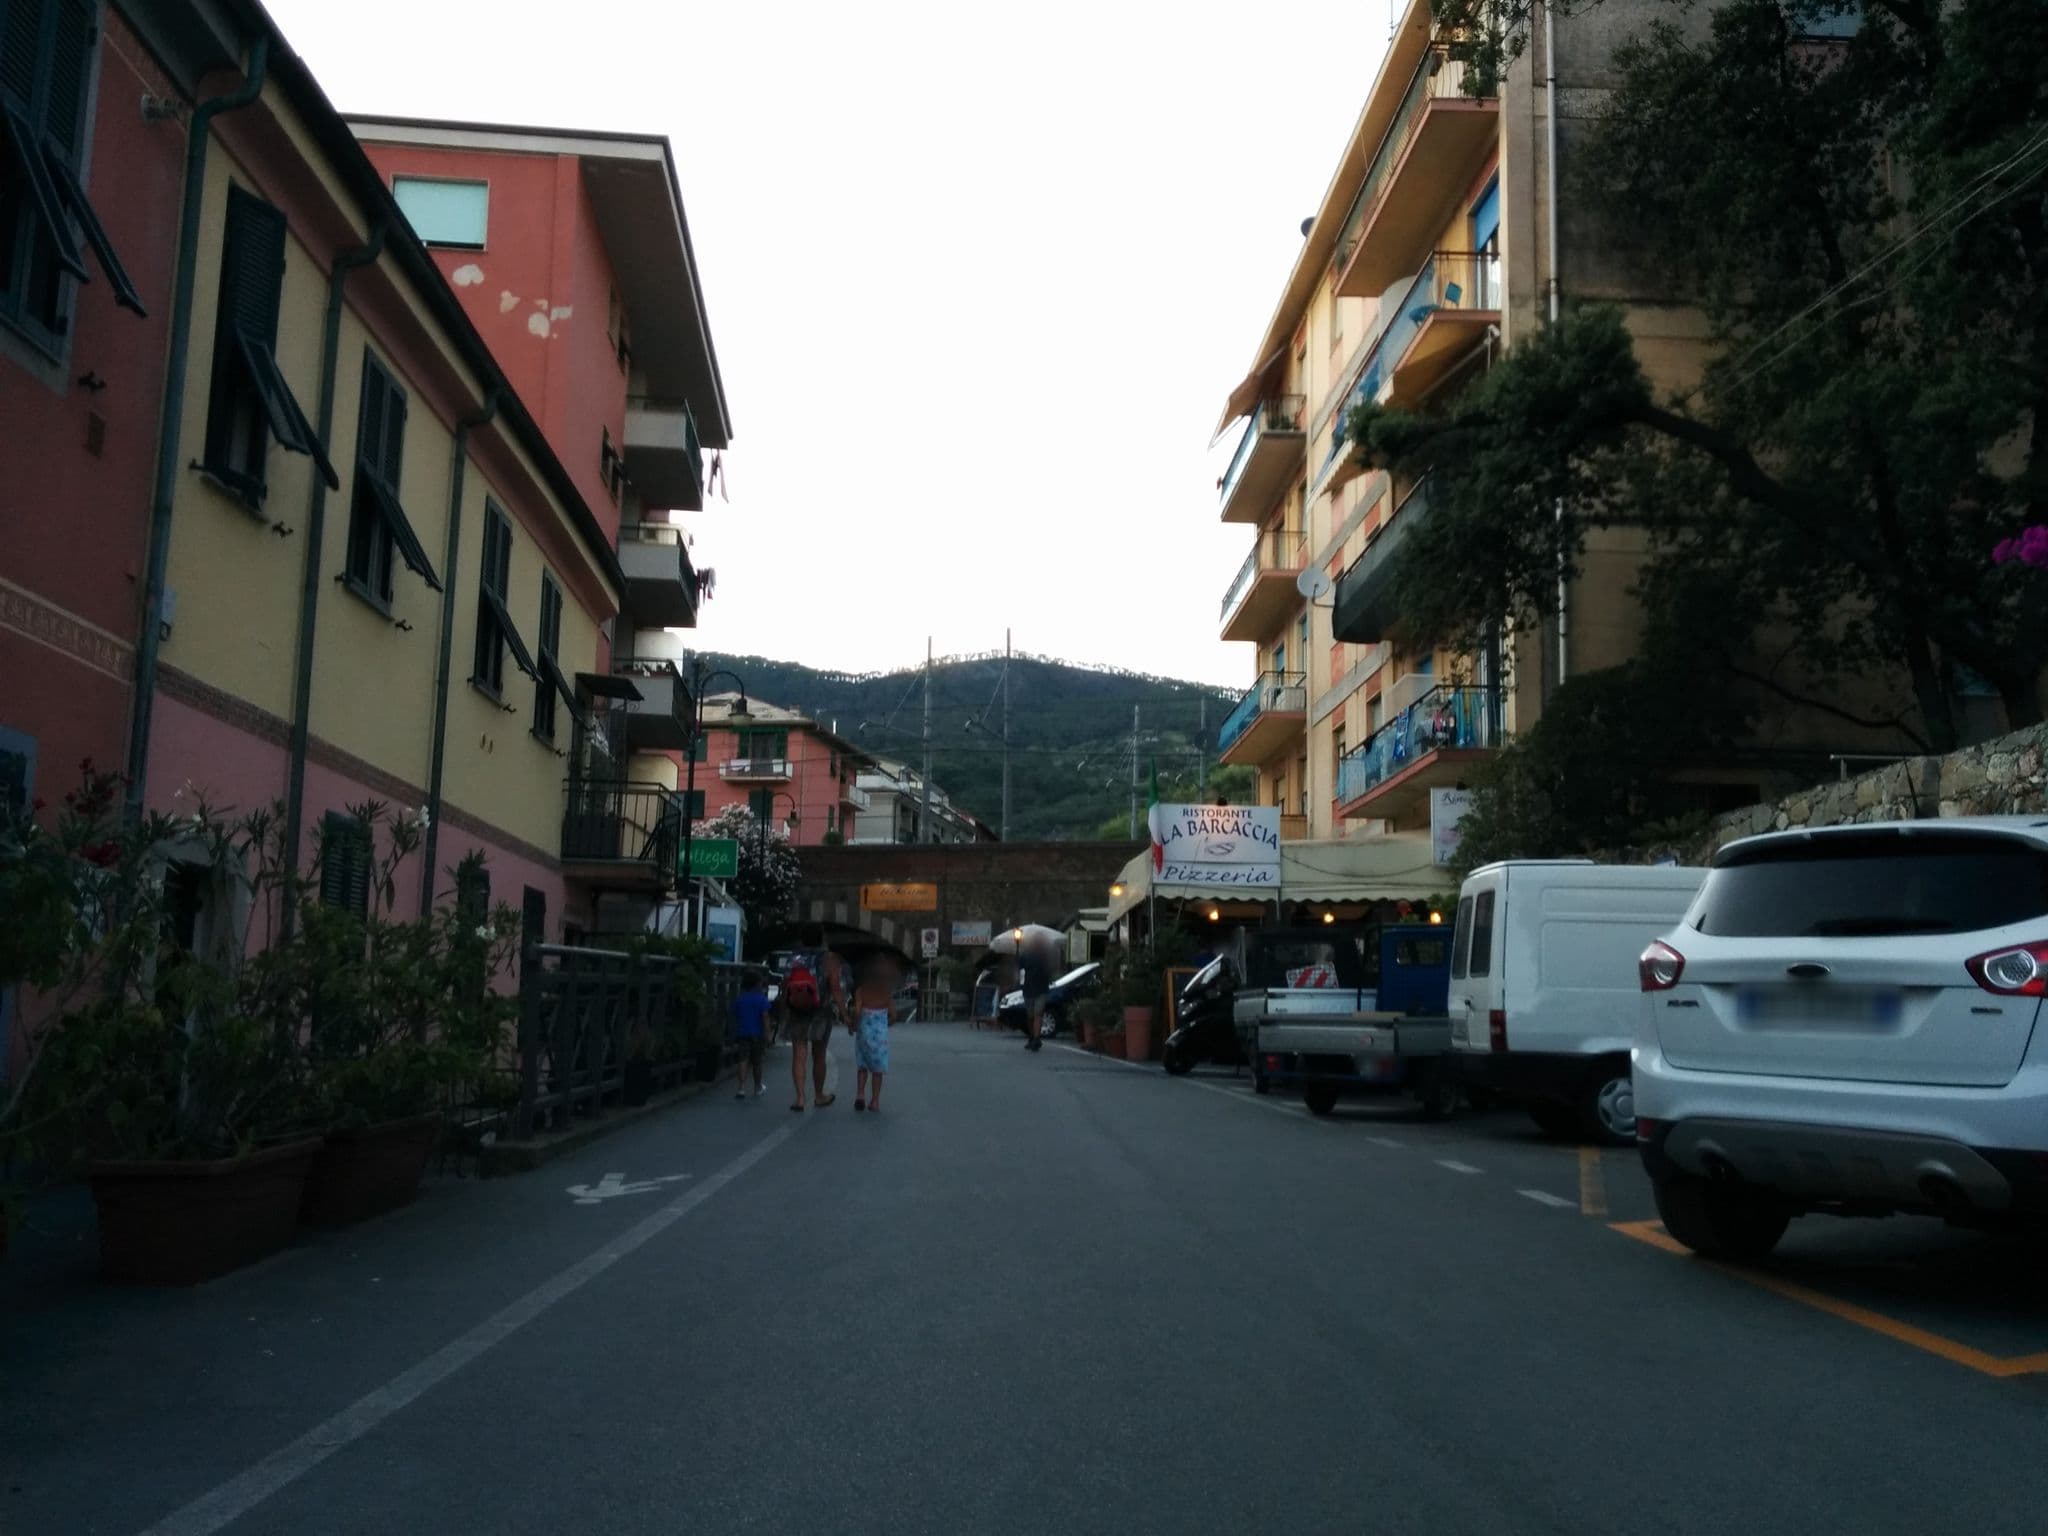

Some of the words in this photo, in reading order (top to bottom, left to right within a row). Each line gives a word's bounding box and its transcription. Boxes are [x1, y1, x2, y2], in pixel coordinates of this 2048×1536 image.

[1182, 808, 1254, 819] RISTORANTE
[1160, 823, 1183, 846] LA
[1187, 818, 1278, 850] BARCACCIA
[1163, 864, 1274, 883] Pizzeria
